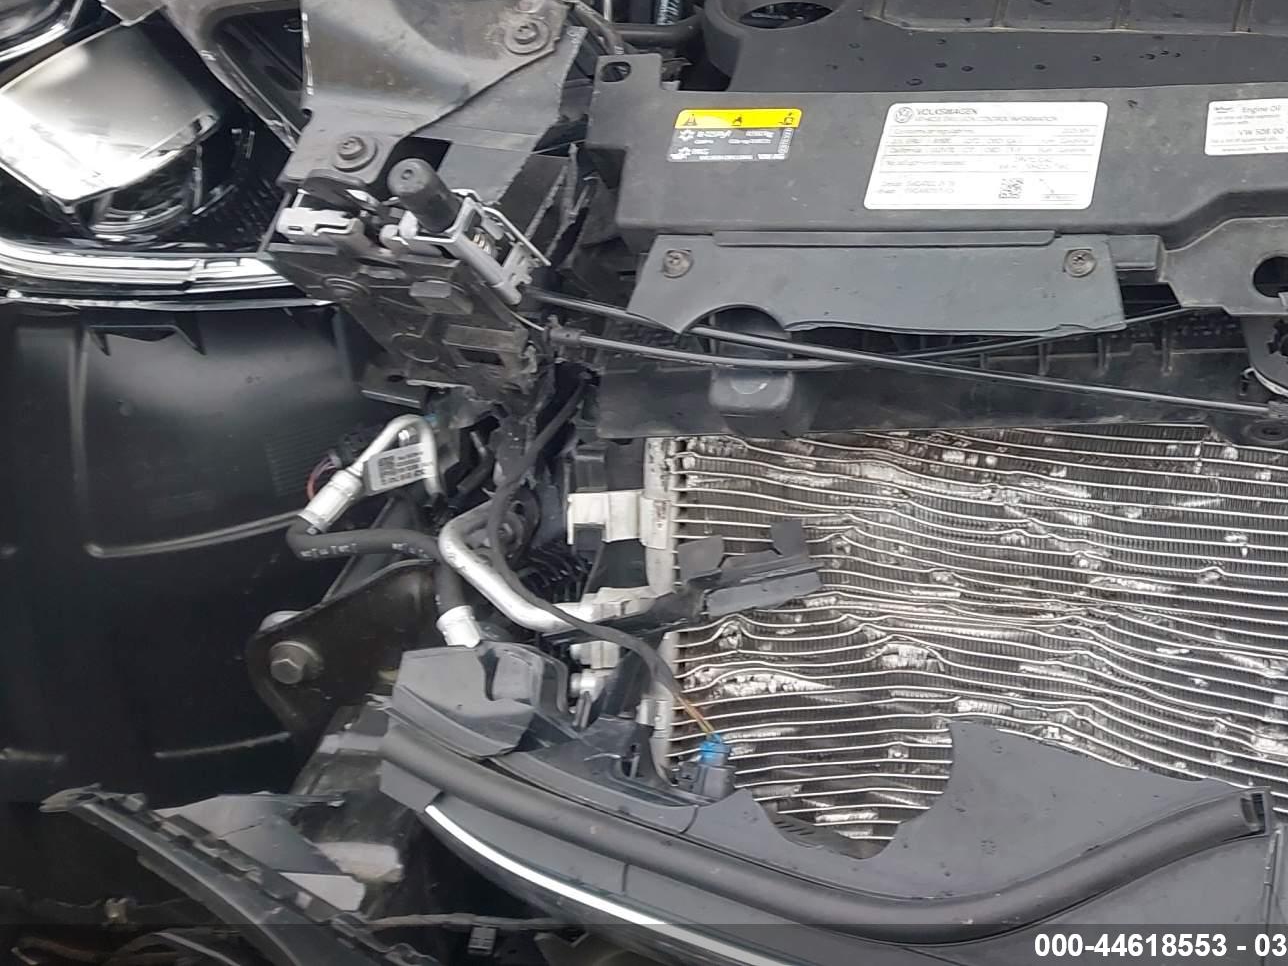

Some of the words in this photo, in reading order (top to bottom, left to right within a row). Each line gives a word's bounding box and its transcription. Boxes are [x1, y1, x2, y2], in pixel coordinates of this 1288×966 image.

[916, 108, 978, 116] VOLKSWAGEN
[1242, 105, 1269, 115] Engine
[1270, 104, 1282, 112] Oil
